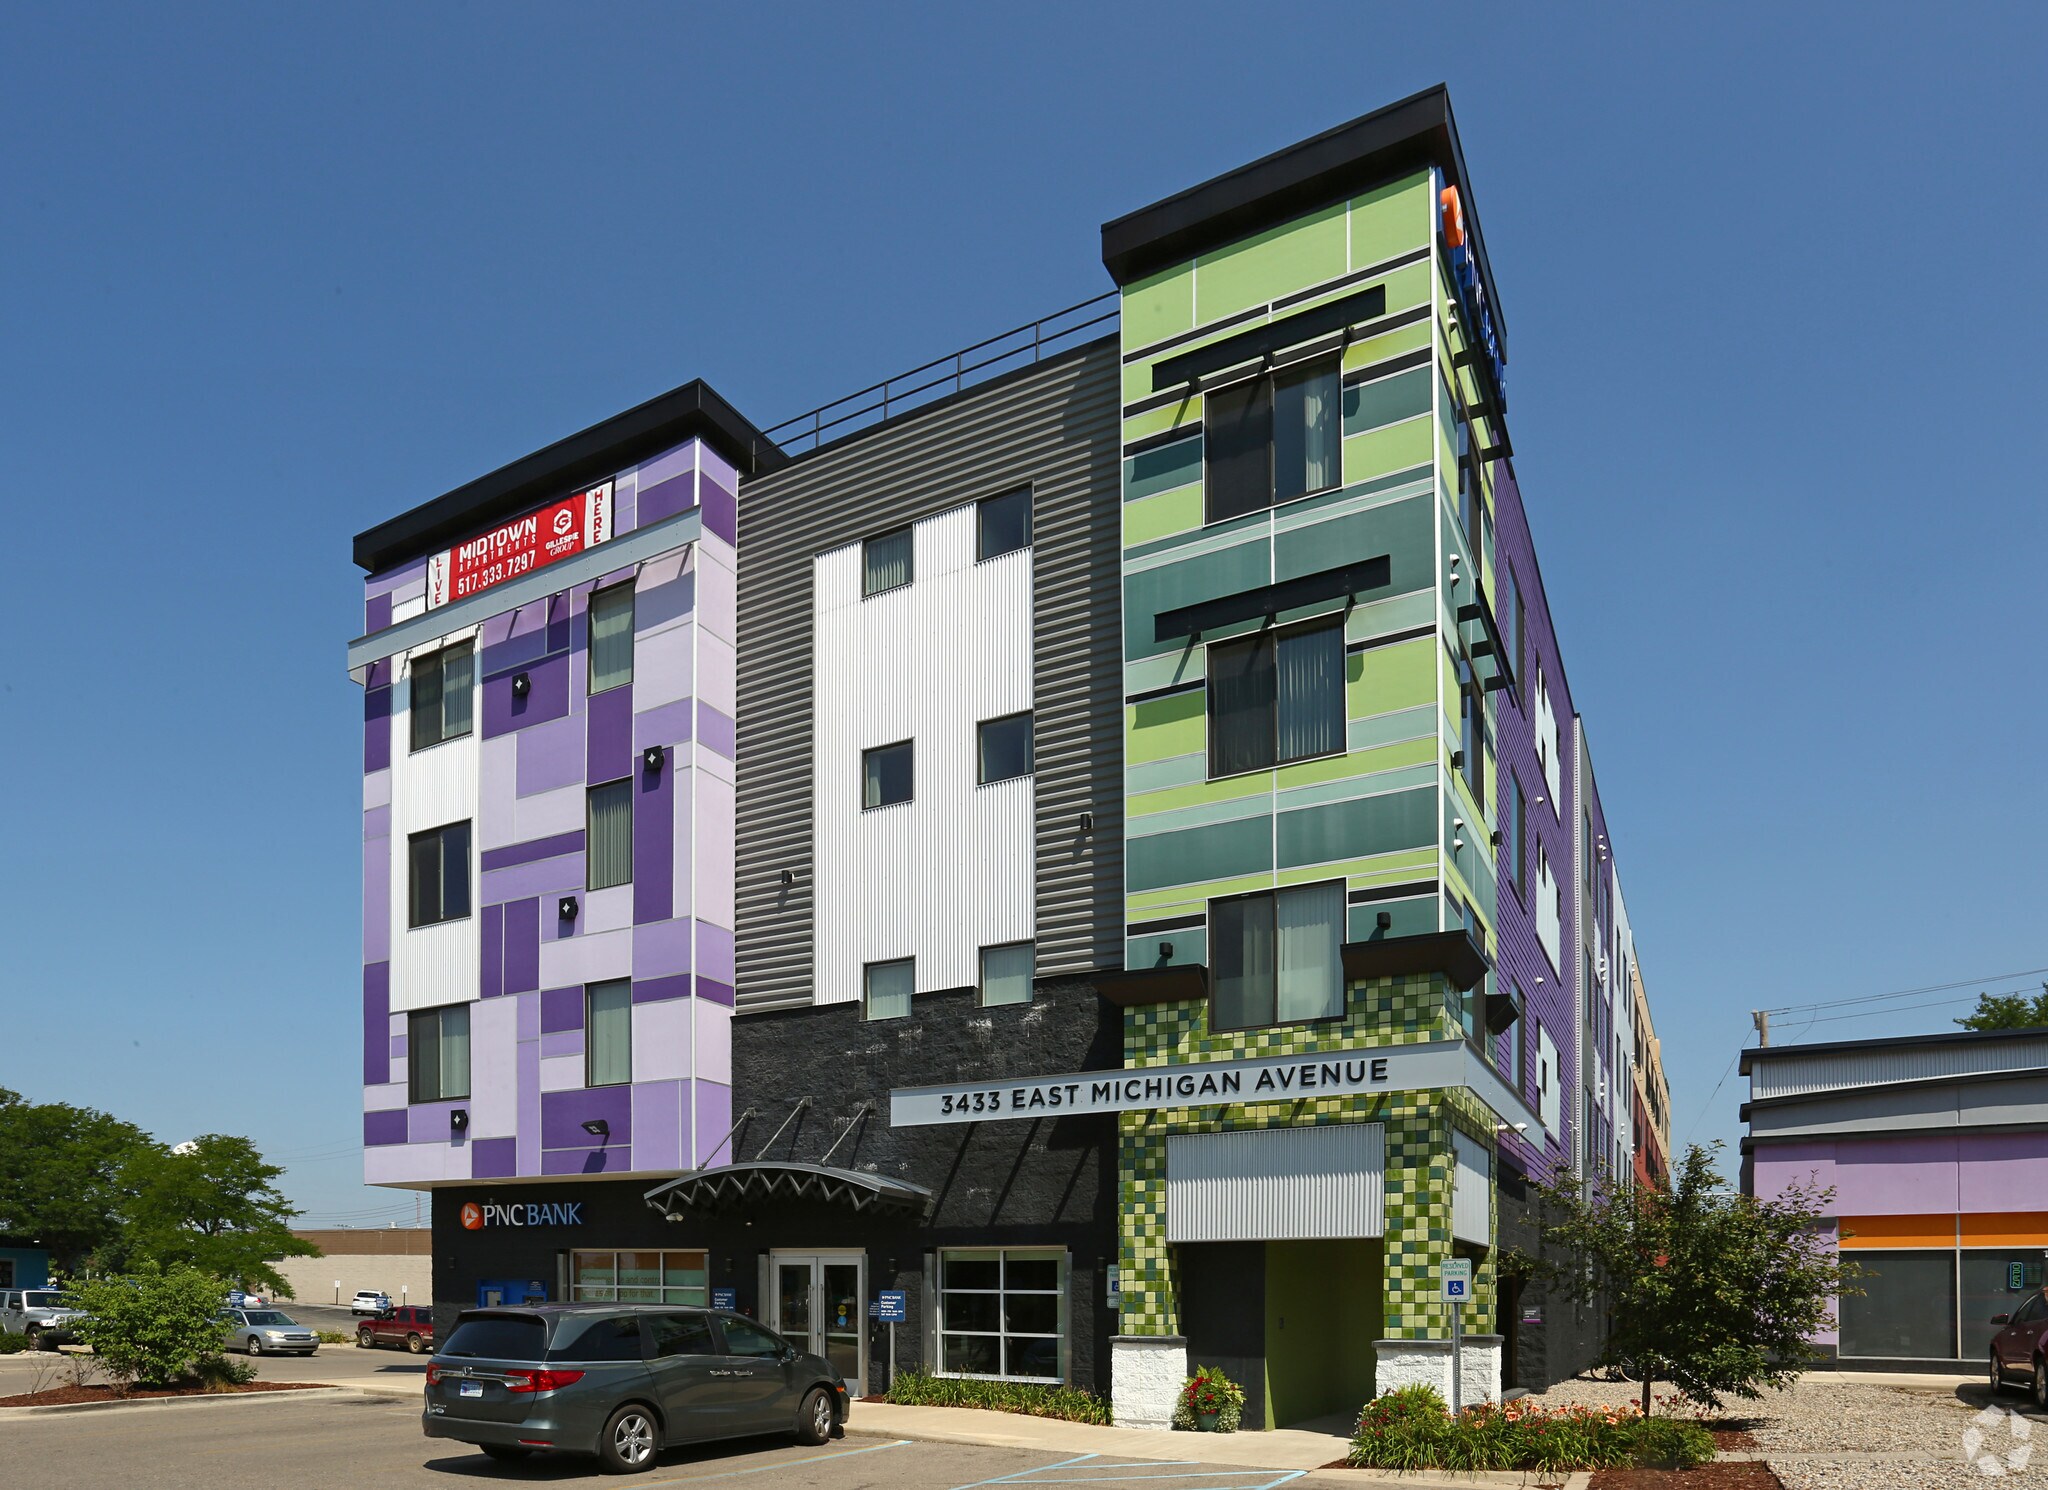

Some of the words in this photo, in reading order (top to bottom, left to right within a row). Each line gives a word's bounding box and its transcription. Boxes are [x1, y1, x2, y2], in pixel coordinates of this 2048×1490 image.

[593, 489, 603, 544] HERE
[459, 516, 537, 562] MIDTOWN
[459, 534, 536, 573] APARTMENTS
[545, 531, 579, 550] GILLESPIE
[550, 541, 574, 556] GROUP
[457, 550, 536, 595] 517.333.7297
[941, 1091, 1000, 1114] 3433
[1011, 1085, 1080, 1109] EAST
[1092, 1071, 1241, 1103] MICHIGAN
[1255, 1058, 1389, 1091] AVENUE
[2013, 1265, 2021, 1287] OPEN
